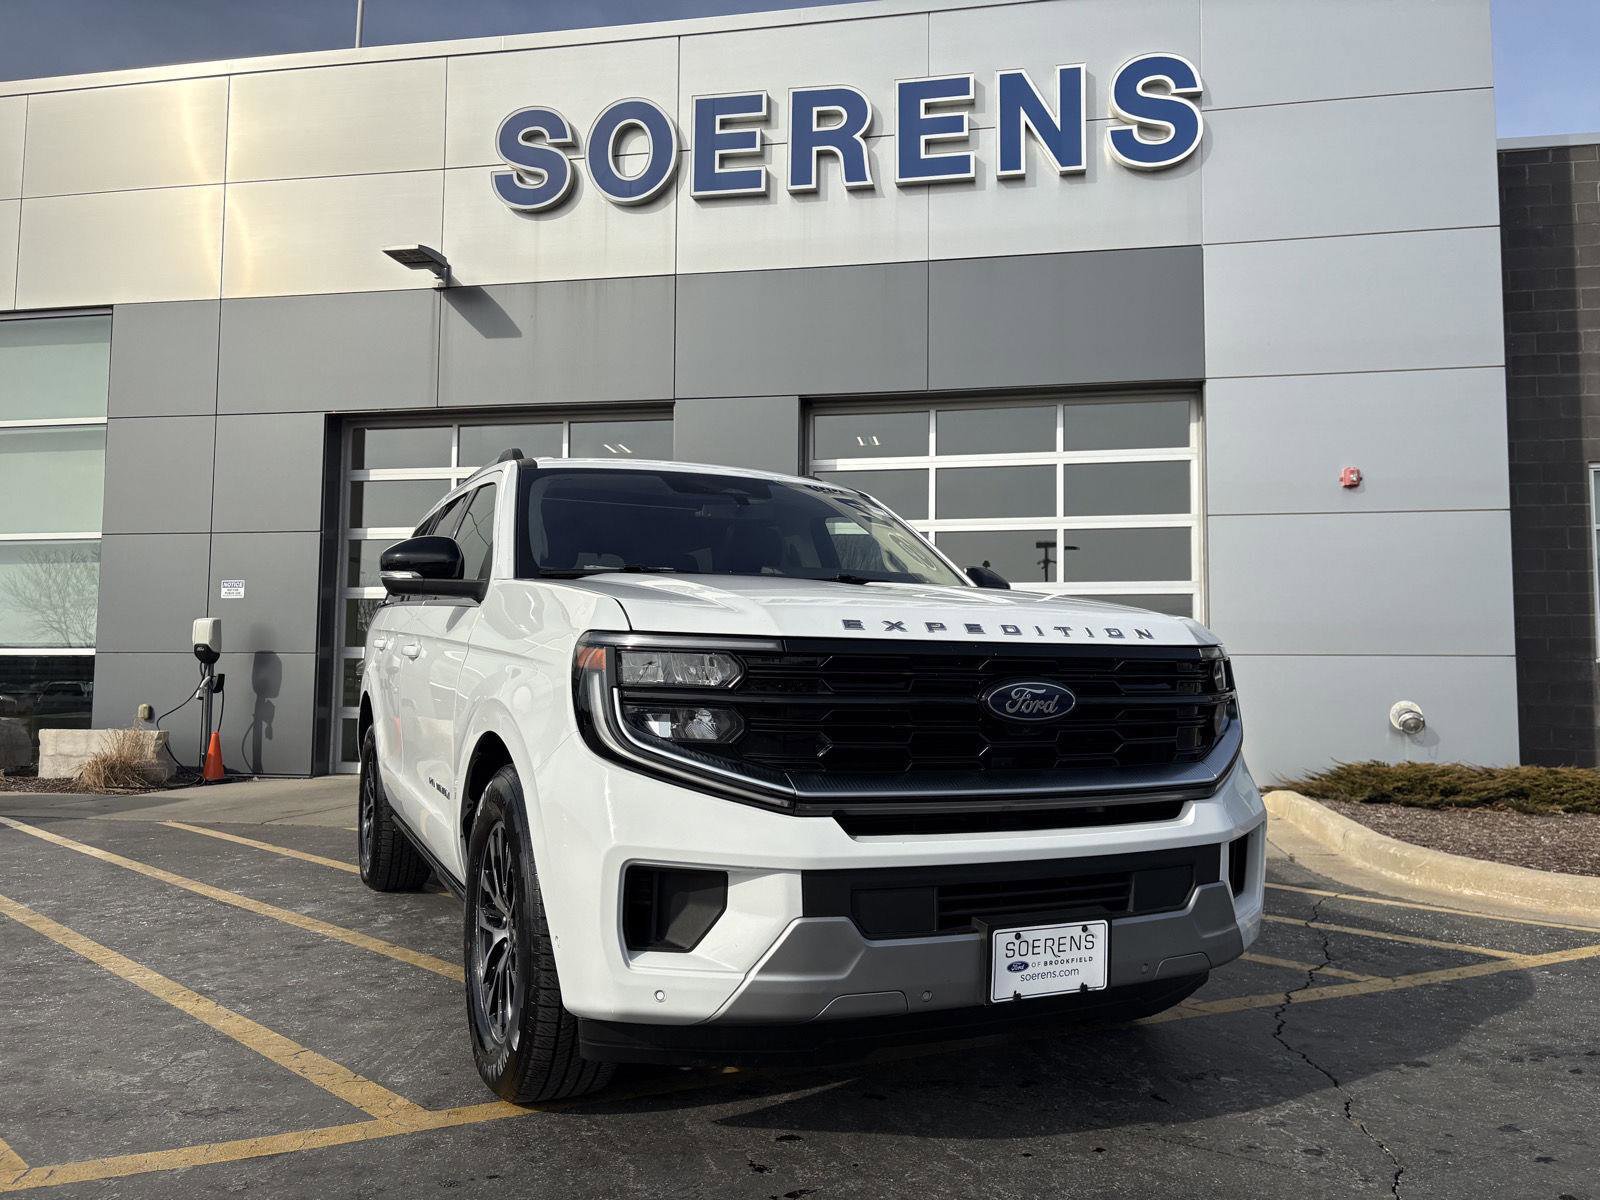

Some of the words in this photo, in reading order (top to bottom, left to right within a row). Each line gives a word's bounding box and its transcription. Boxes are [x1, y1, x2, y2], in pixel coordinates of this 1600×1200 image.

[490, 51, 1204, 213] SOERENS
[841, 619, 1155, 640] EXPEDITION
[1004, 687, 1059, 714] Ford
[1005, 934, 1095, 958] SOERENS
[1044, 956, 1093, 967] BROOKFIELD
[1020, 968, 1080, 982] soerens.com
